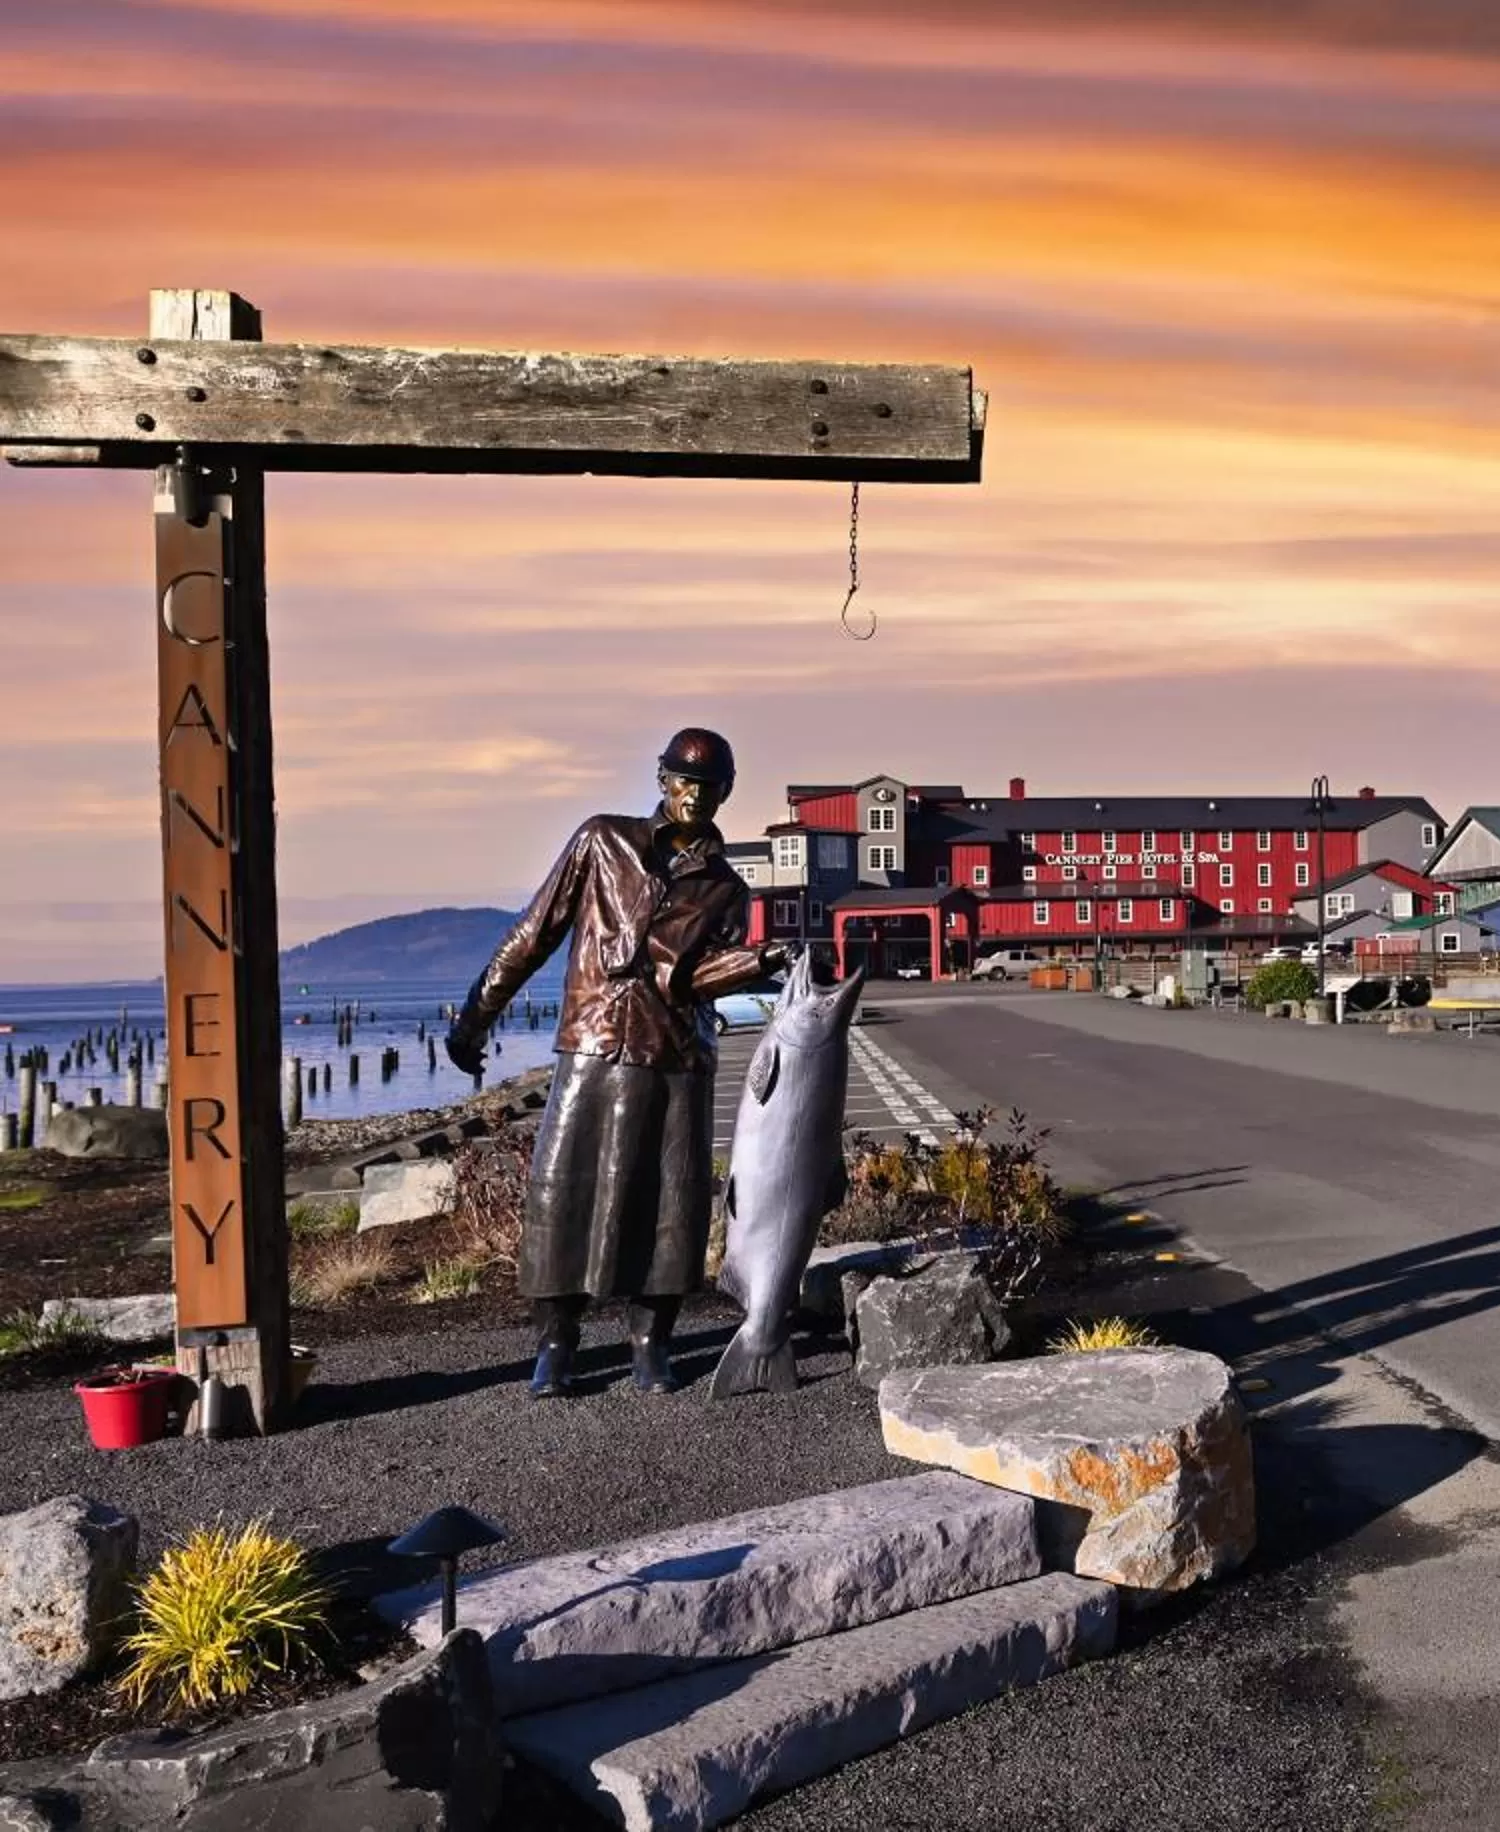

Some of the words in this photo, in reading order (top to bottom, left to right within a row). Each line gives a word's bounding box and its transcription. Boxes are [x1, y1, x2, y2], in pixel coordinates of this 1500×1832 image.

[159, 570, 236, 1265] CANNERY
[1045, 853, 1102, 865] CANNERY
[1107, 852, 1134, 865] PIER
[1138, 851, 1178, 865] HOTEL
[1181, 850, 1196, 863] &
[1198, 851, 1220, 863] SPA
